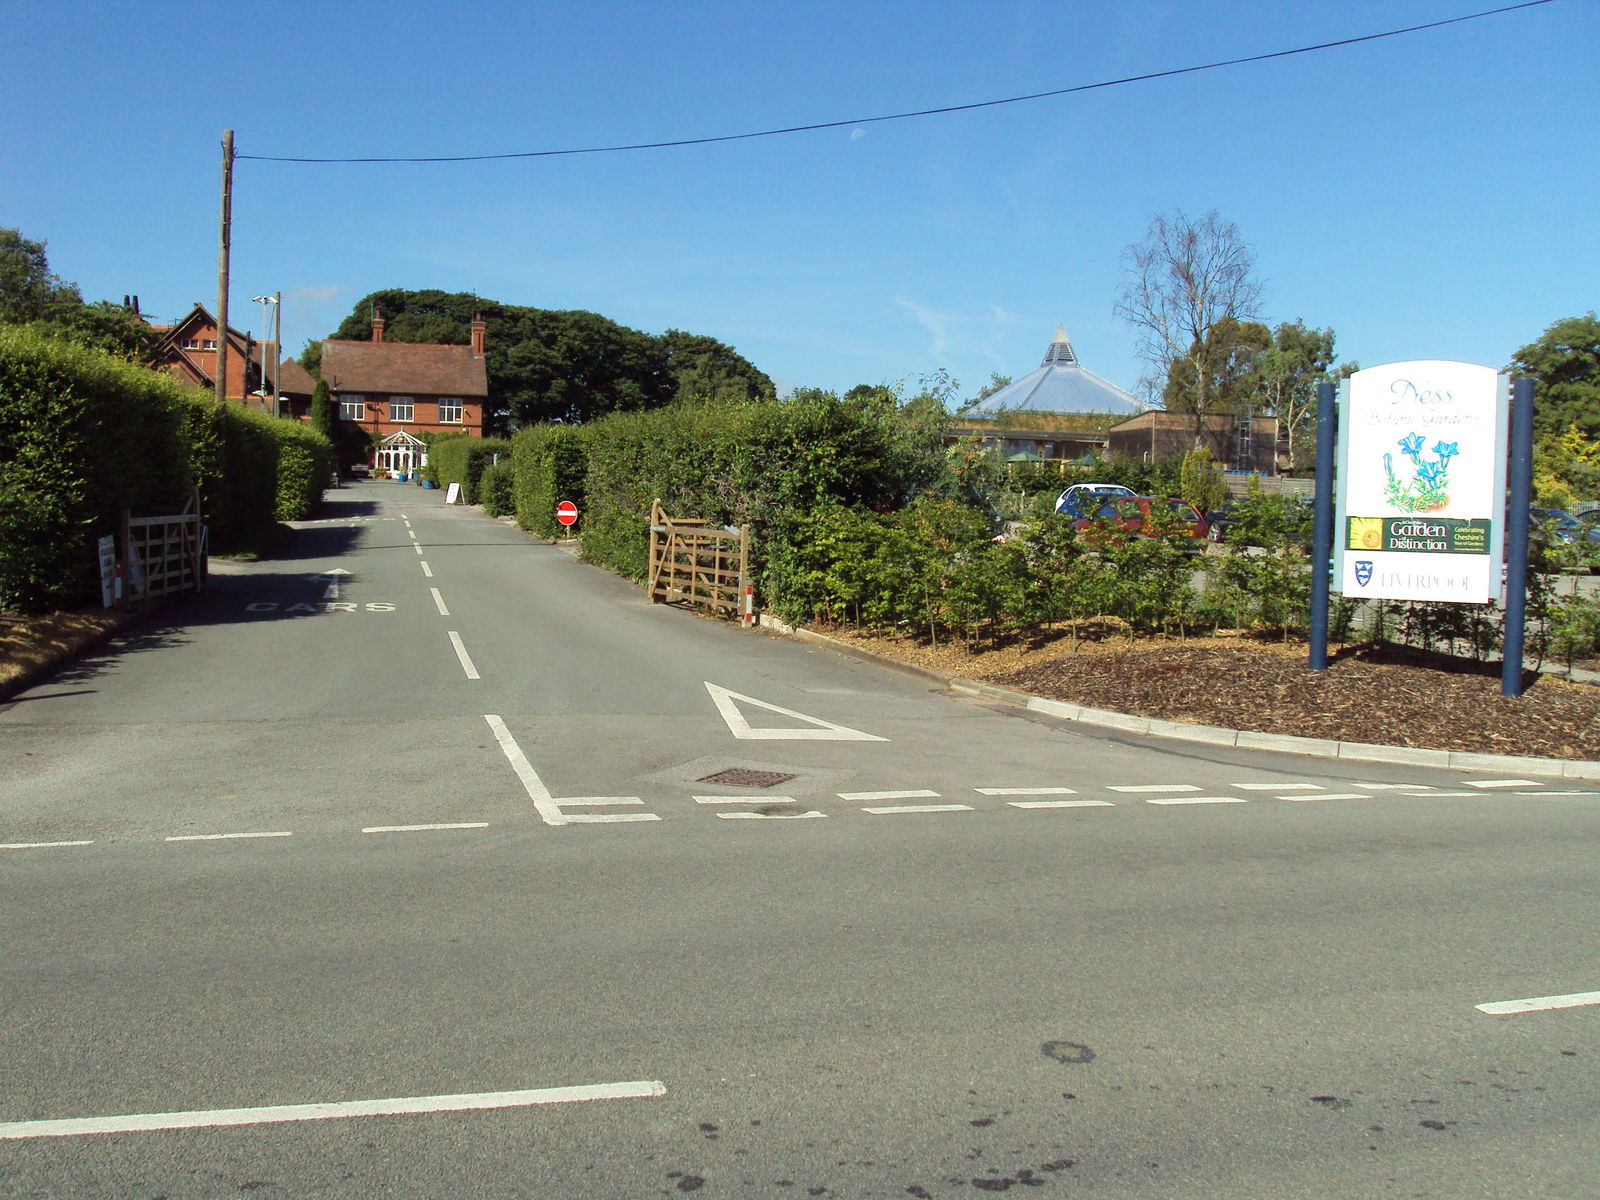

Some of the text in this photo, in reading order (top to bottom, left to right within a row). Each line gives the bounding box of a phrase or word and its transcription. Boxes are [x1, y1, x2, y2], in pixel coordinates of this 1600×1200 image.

[1390, 521, 1446, 537] Garden
[1389, 537, 1447, 550] Distinction
[245, 602, 397, 613] CARS
